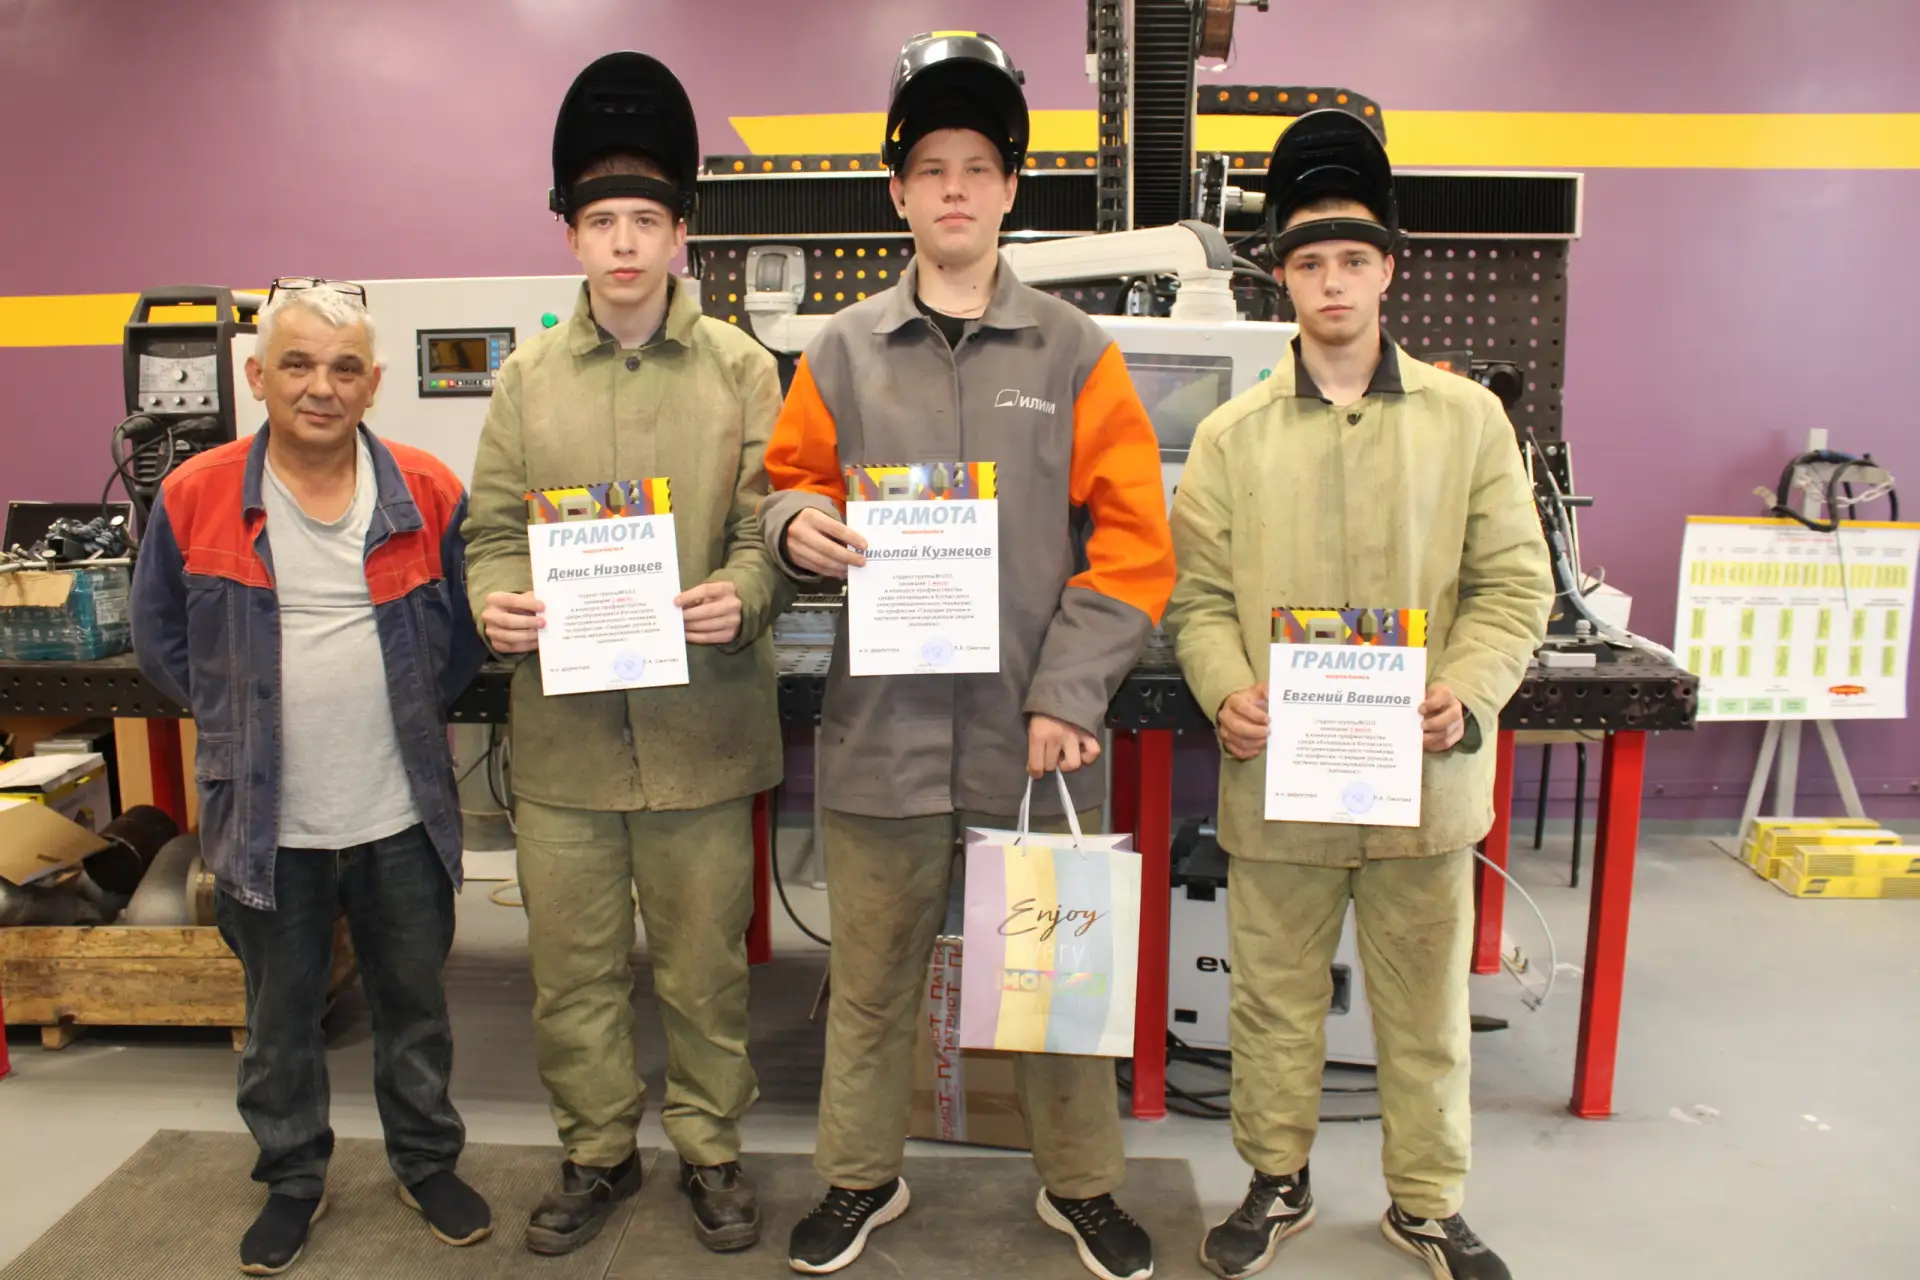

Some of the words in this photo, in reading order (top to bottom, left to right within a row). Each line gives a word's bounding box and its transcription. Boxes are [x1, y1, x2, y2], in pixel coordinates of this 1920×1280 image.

[1020, 395, 1056, 414] ИЛИМ
[867, 505, 977, 526] ГРАМОТА
[549, 521, 655, 547] ГРАМОТА
[921, 545, 992, 560] Кузнецов
[547, 567, 590, 582] Денис
[594, 561, 662, 577] Низовцев
[1291, 650, 1404, 671] ГРАМОТА
[1283, 689, 1342, 703] Евгений
[1347, 691, 1411, 705] Вавилов
[997, 898, 1110, 942] Enjoy
